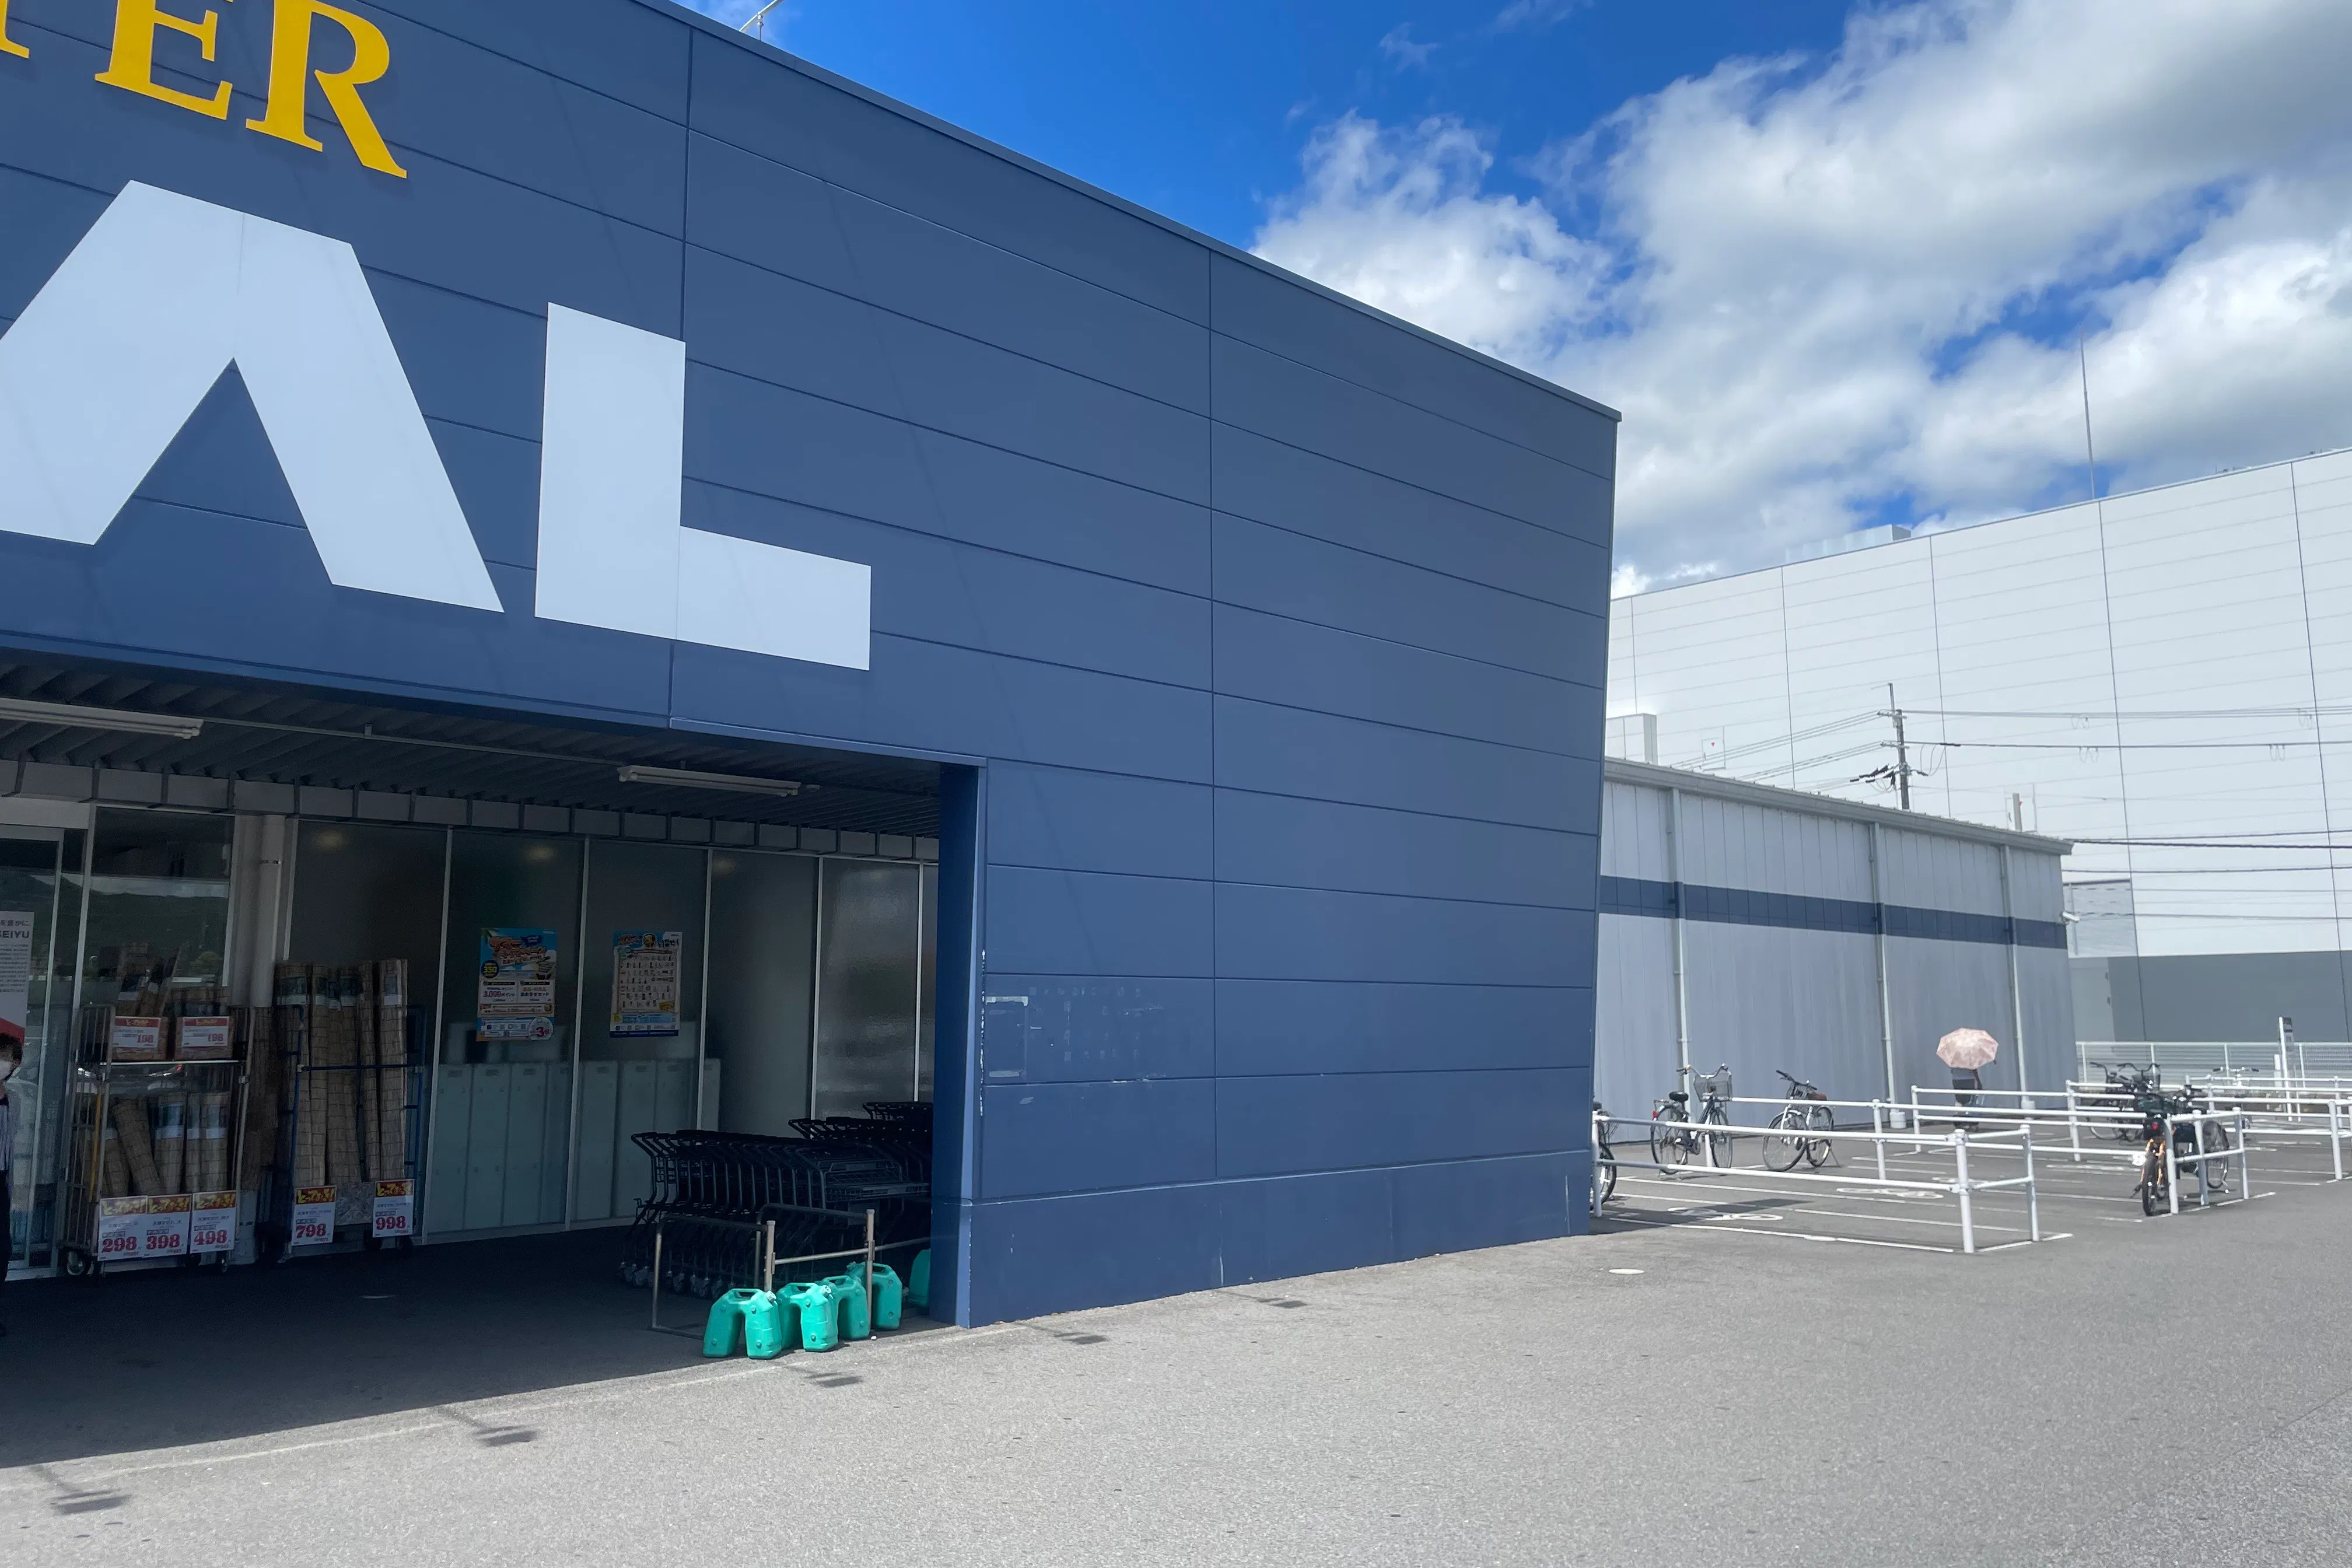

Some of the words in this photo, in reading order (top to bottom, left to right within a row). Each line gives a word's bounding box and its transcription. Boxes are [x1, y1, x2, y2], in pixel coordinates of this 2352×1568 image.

[0, 0, 407, 178] ER
[0, 180, 872, 671] AL
[0, 930, 30, 939] EIYU
[296, 1223, 327, 1238] 798
[376, 1216, 406, 1230] 998
[102, 1236, 137, 1253] 298
[146, 1234, 180, 1250] 398
[194, 1230, 227, 1245] 498
